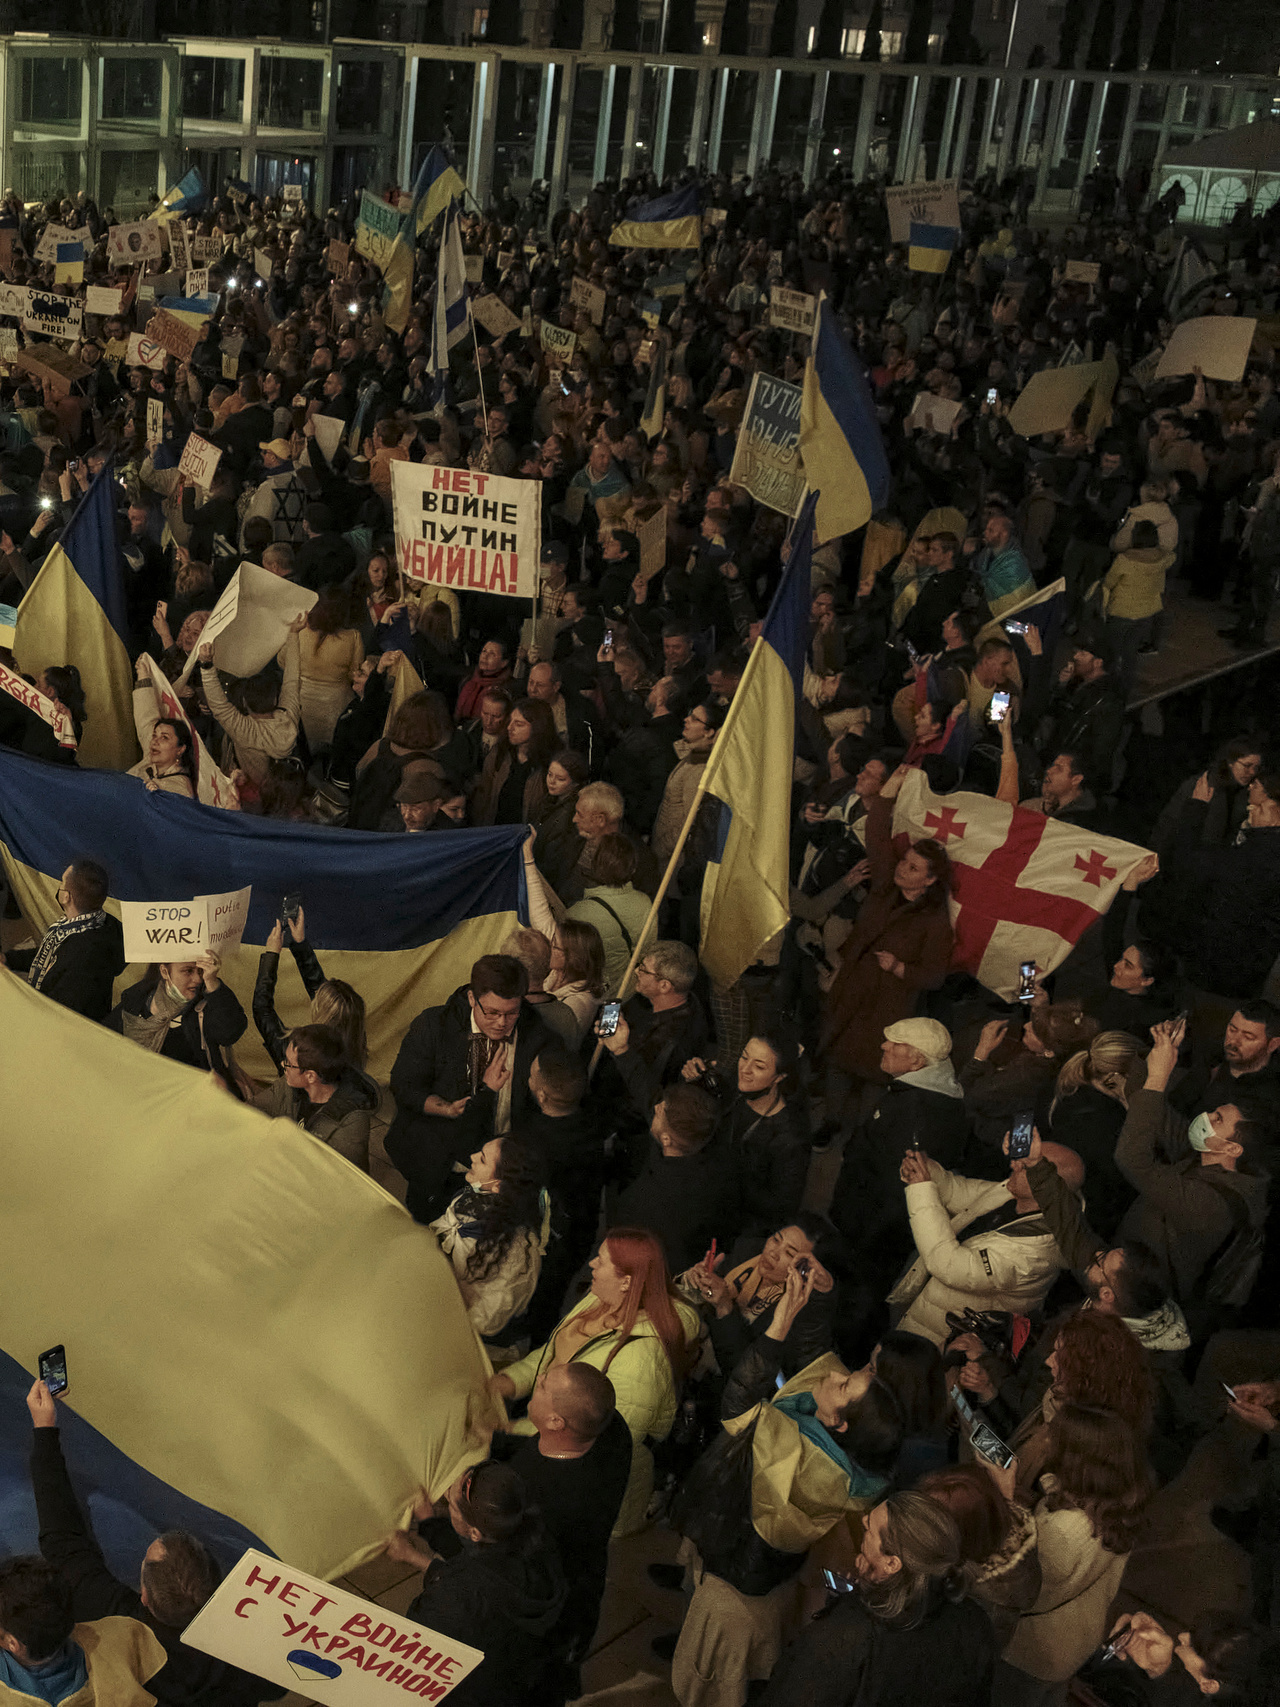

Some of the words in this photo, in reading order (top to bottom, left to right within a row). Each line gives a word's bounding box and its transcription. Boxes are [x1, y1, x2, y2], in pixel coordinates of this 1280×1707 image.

[199, 239, 219, 249] STOP
[205, 247, 220, 259] WAR
[27, 290, 58, 304] STOP
[41, 323, 66, 336] FIRE!
[67, 317, 80, 325] ON
[759, 380, 802, 421] ПУТИ
[187, 433, 209, 455] STOP
[180, 448, 208, 478] PUTIN
[433, 468, 489, 496] НЕТ
[422, 491, 517, 525] ВОЙНЕ
[422, 520, 517, 553] ПУТИН
[401, 537, 518, 593] УБИЙЦА!
[146, 908, 191, 922] STOP
[146, 921, 202, 944] WAR!
[244, 1565, 338, 1618] НЕТ
[340, 1612, 464, 1681] ВОЙНЕ
[234, 1597, 259, 1619] С
[281, 1612, 455, 1702] УКРАИНОЙ
